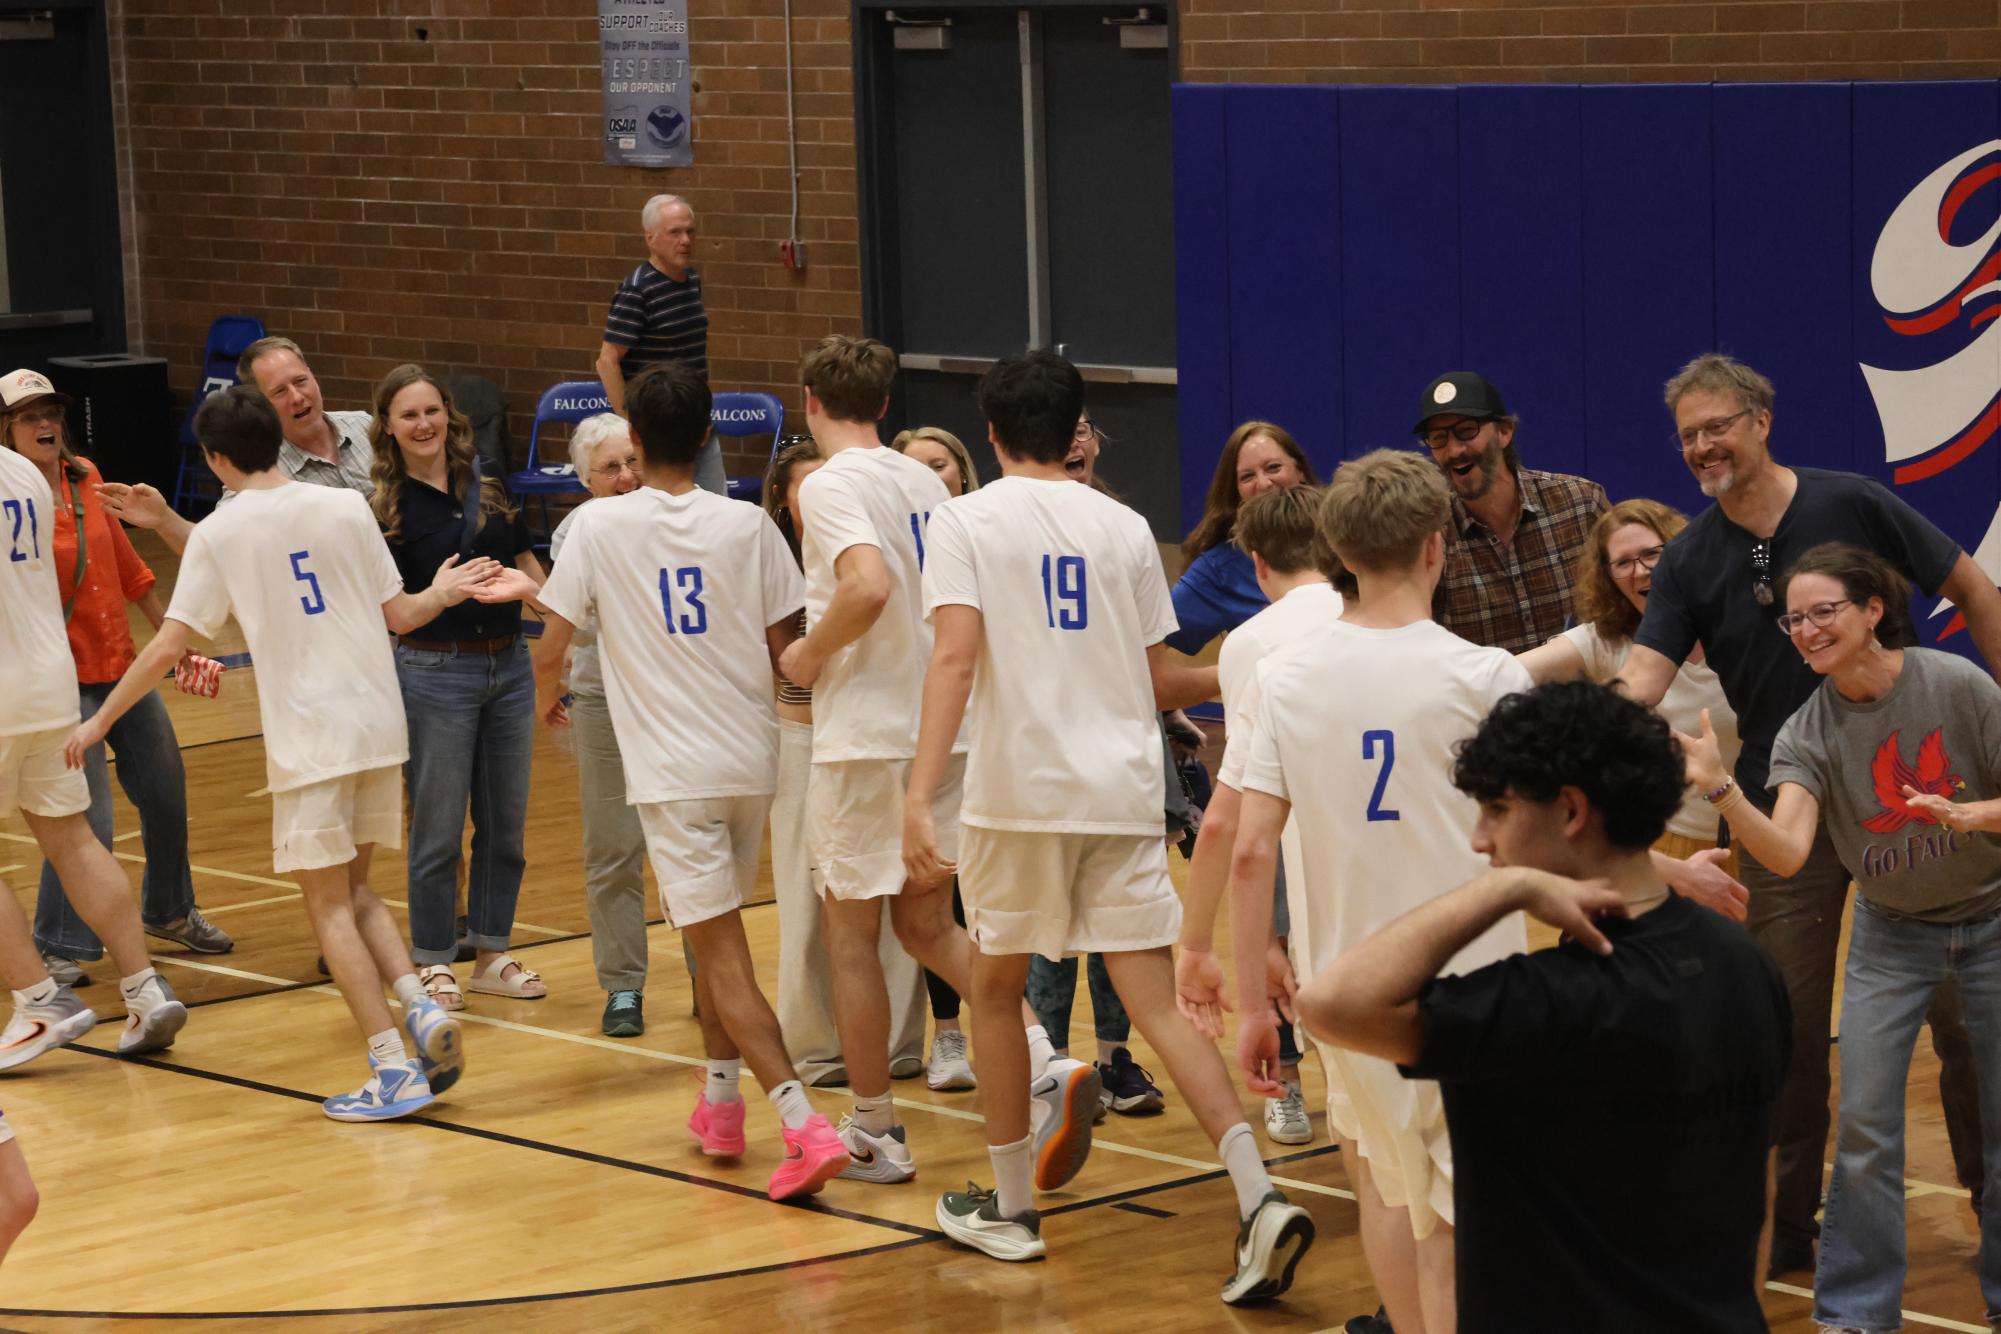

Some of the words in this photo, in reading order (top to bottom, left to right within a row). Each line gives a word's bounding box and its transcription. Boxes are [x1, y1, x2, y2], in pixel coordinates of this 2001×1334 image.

[600, 15, 649, 29] SUPPORT
[649, 22, 685, 33] COACHES
[622, 41, 637, 50] OFF
[610, 82, 628, 93] OUR
[631, 82, 677, 93] OPPONENT
[609, 118, 637, 132] OSAA
[711, 409, 766, 421] ALCONS
[3, 498, 39, 562] 21
[911, 511, 930, 575] 1
[290, 551, 326, 615] 5
[659, 566, 707, 634] 13
[1042, 554, 1087, 630] 19
[1362, 730, 1400, 821] 2
[1904, 828, 1977, 871] FALC
